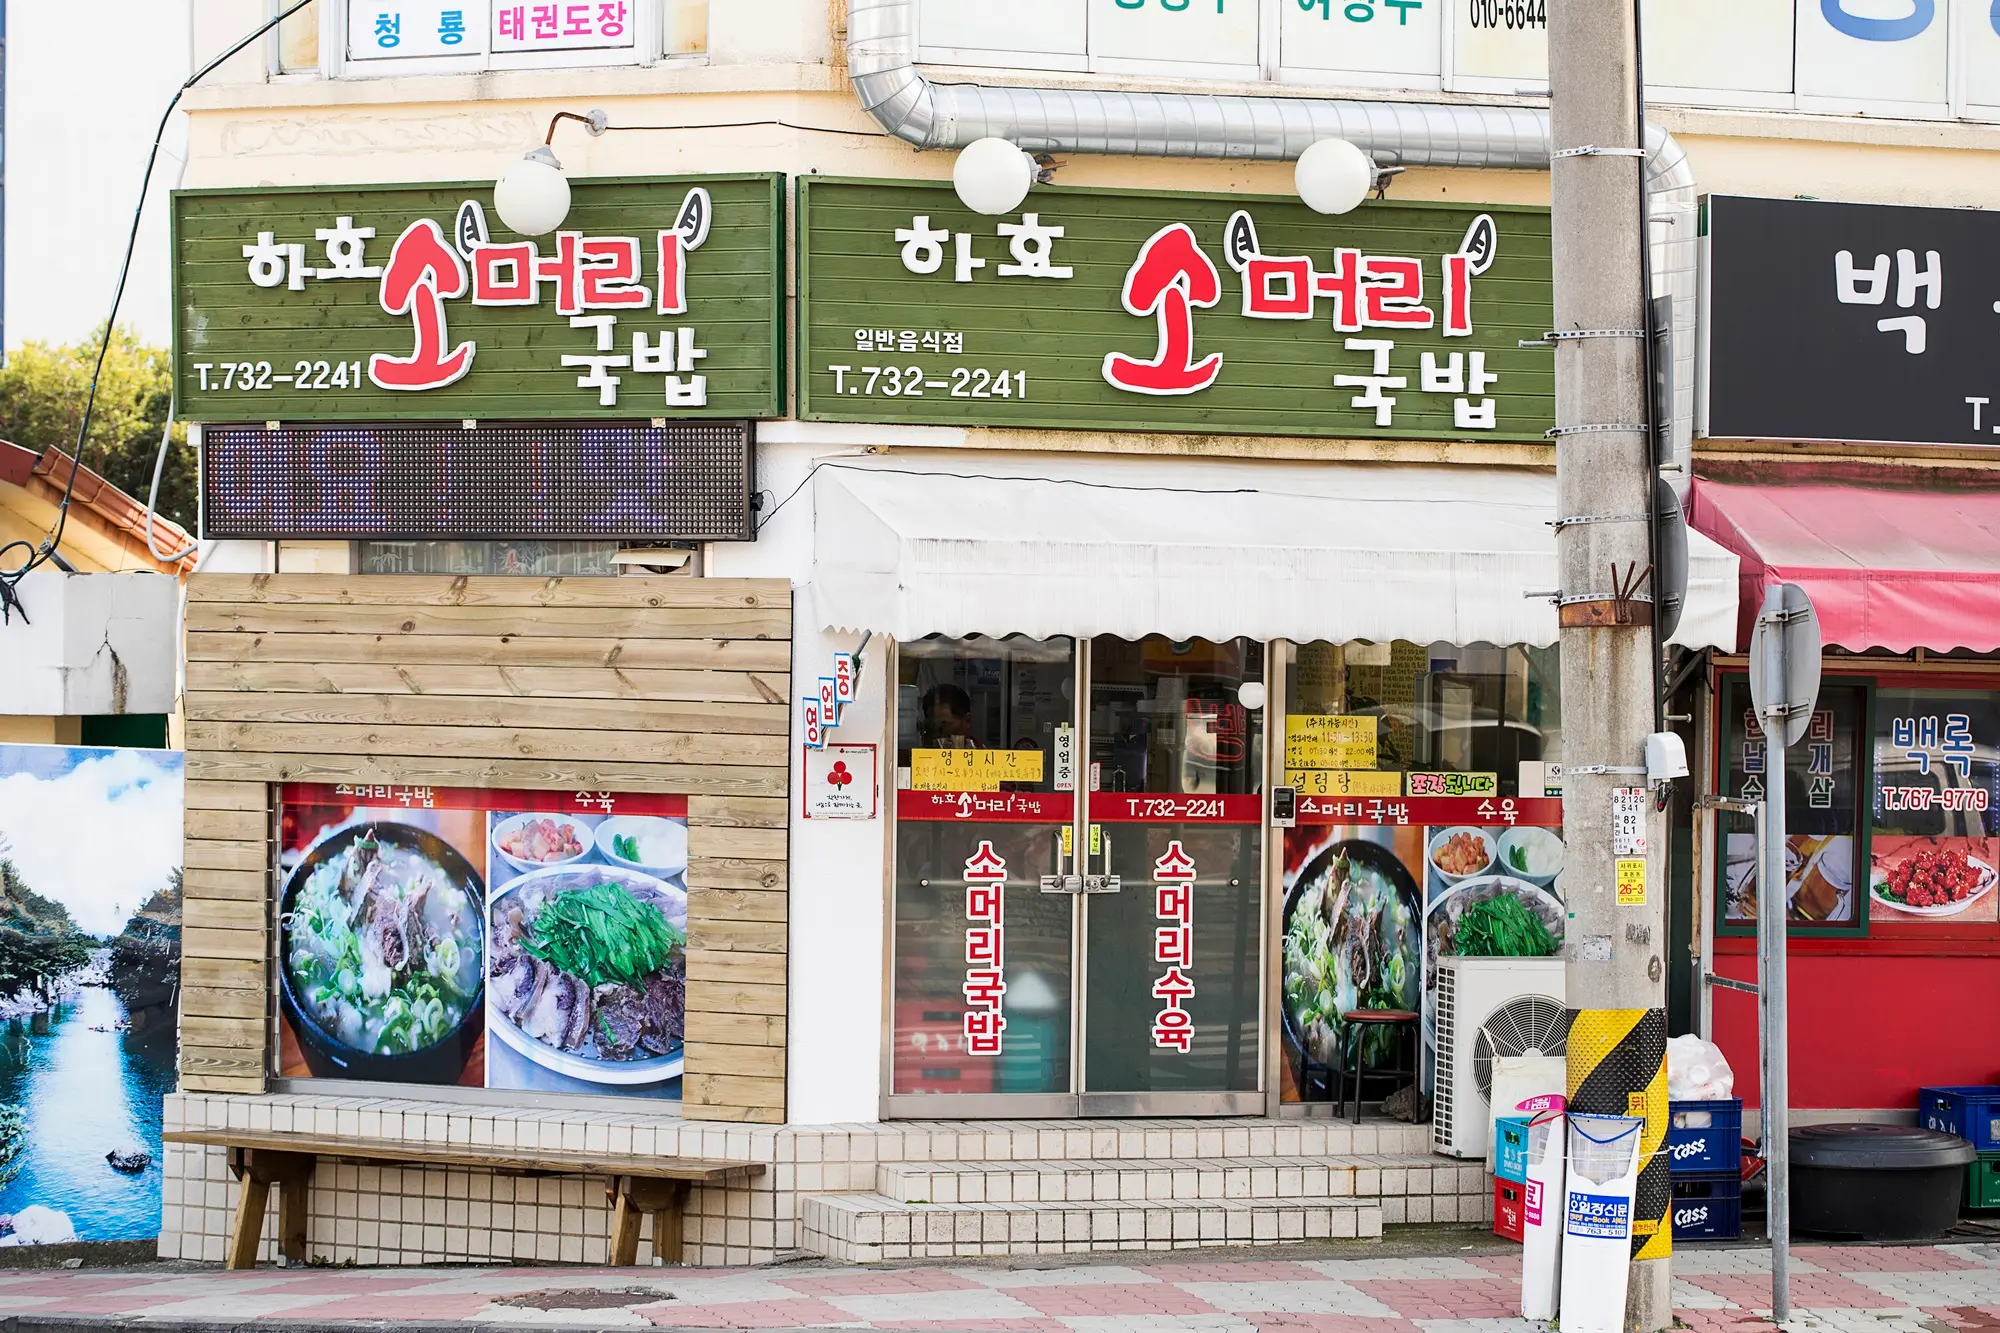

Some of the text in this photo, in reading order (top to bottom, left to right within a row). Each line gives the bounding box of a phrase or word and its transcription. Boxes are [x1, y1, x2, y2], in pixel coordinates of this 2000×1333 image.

[499, 1, 627, 41] 태권도장
[1834, 248, 1942, 355] 백
[853, 328, 964, 355] 일반음식점
[193, 359, 363, 391] T.732-2241
[561, 315, 707, 406] 국밥
[828, 365, 1028, 400] T.732-2241
[1333, 338, 1498, 429] 국밥
[1058, 734, 1071, 779] 영업중
[1892, 713, 1975, 778] 백록
[1292, 772, 1351, 794] 설렁탕
[1126, 798, 1225, 818] T.732-2241
[1300, 797, 1409, 825] 소머리국밥
[1477, 799, 1519, 825] 수육
[1882, 787, 1988, 812] T.767-9779
[1623, 815, 1636, 824] 82
[1619, 883, 1643, 895] 26-3
[964, 841, 1007, 1055] 소머리국밥
[1153, 841, 1196, 1053] 소머리수육
[1569, 1199, 1628, 1217] 오일장신문
